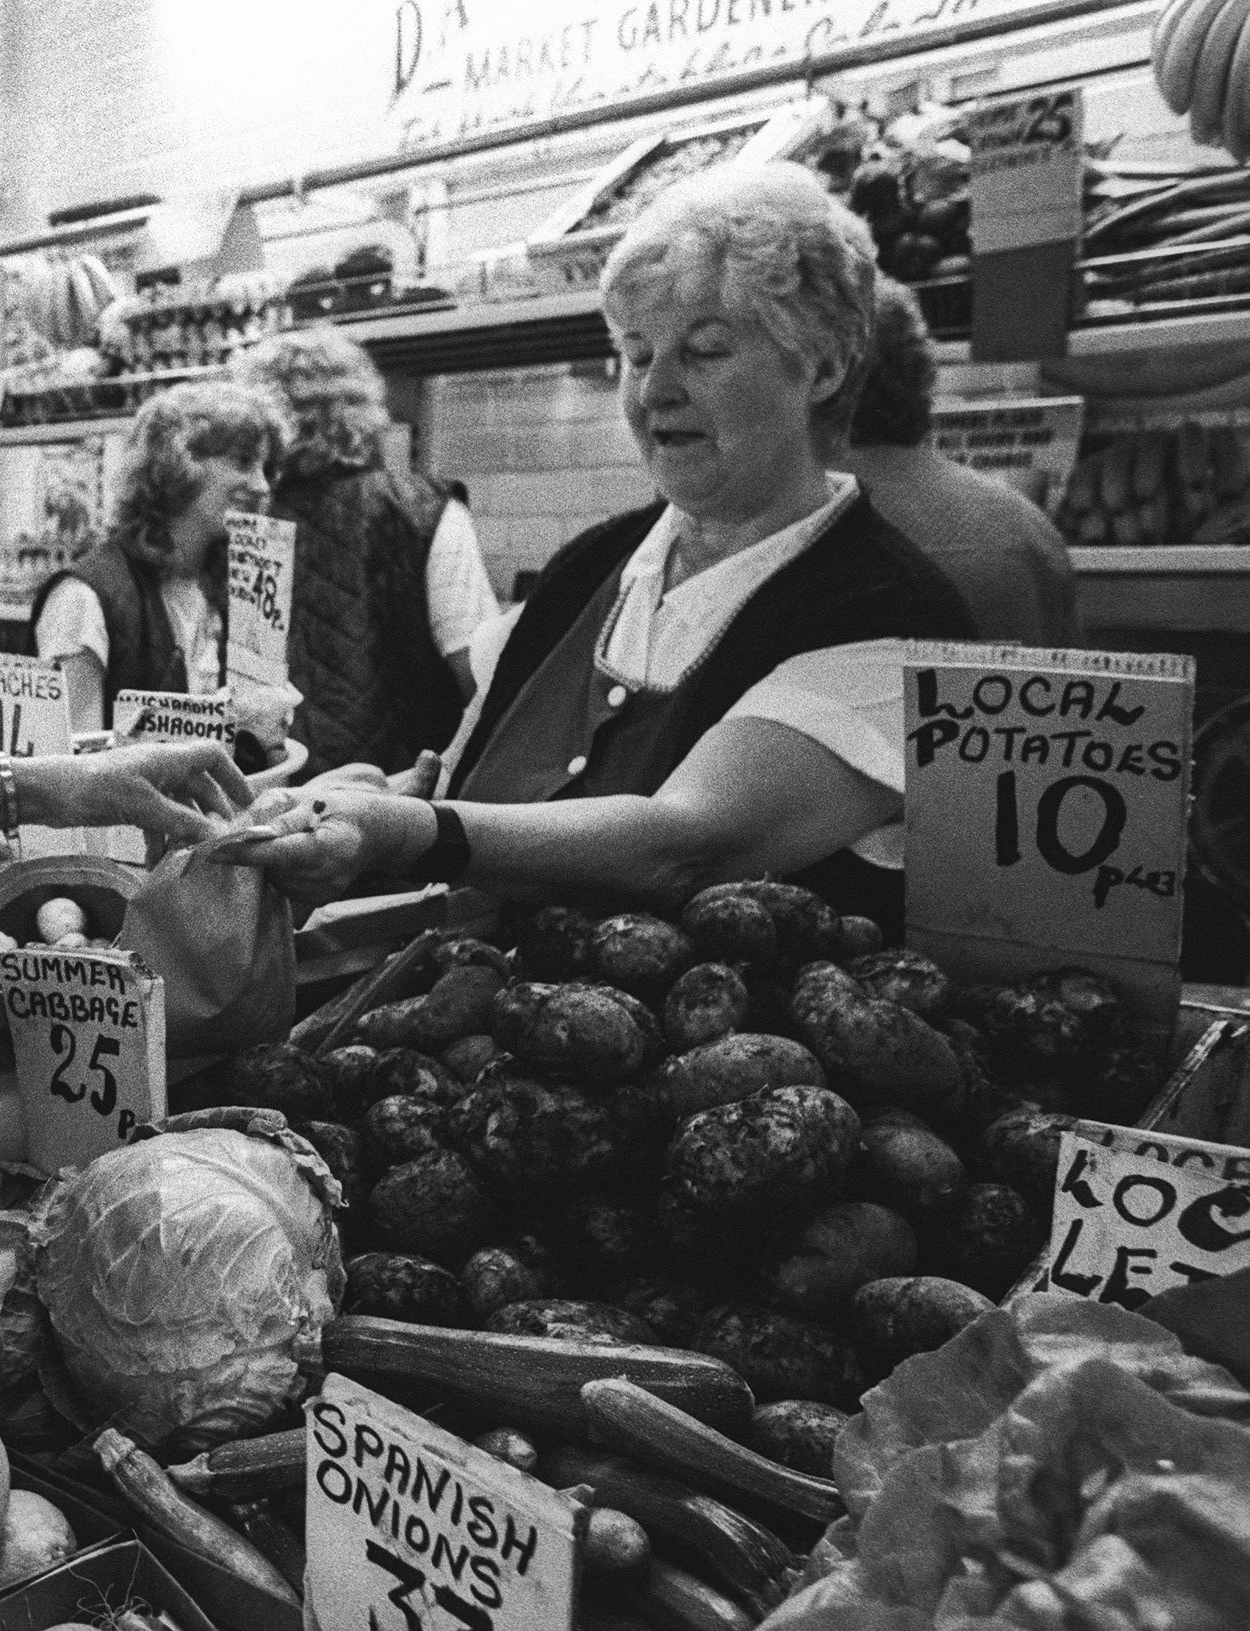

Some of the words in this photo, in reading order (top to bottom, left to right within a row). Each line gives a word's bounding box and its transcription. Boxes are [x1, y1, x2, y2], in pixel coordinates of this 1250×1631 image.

[463, 18, 599, 94] MARKET
[1022, 92, 1072, 144] 25
[916, 668, 1145, 726] LOCAL
[137, 713, 236, 744] SHROOMS
[906, 718, 1182, 782] POTATOES
[995, 770, 1127, 875] 10
[1, 953, 126, 995] SUMMER
[7, 986, 138, 1028] CABBAGE
[50, 1024, 120, 1117] 25
[118, 1109, 136, 1139] P
[313, 1402, 538, 1576] SPANISH
[316, 1458, 503, 1610] ONIONS
